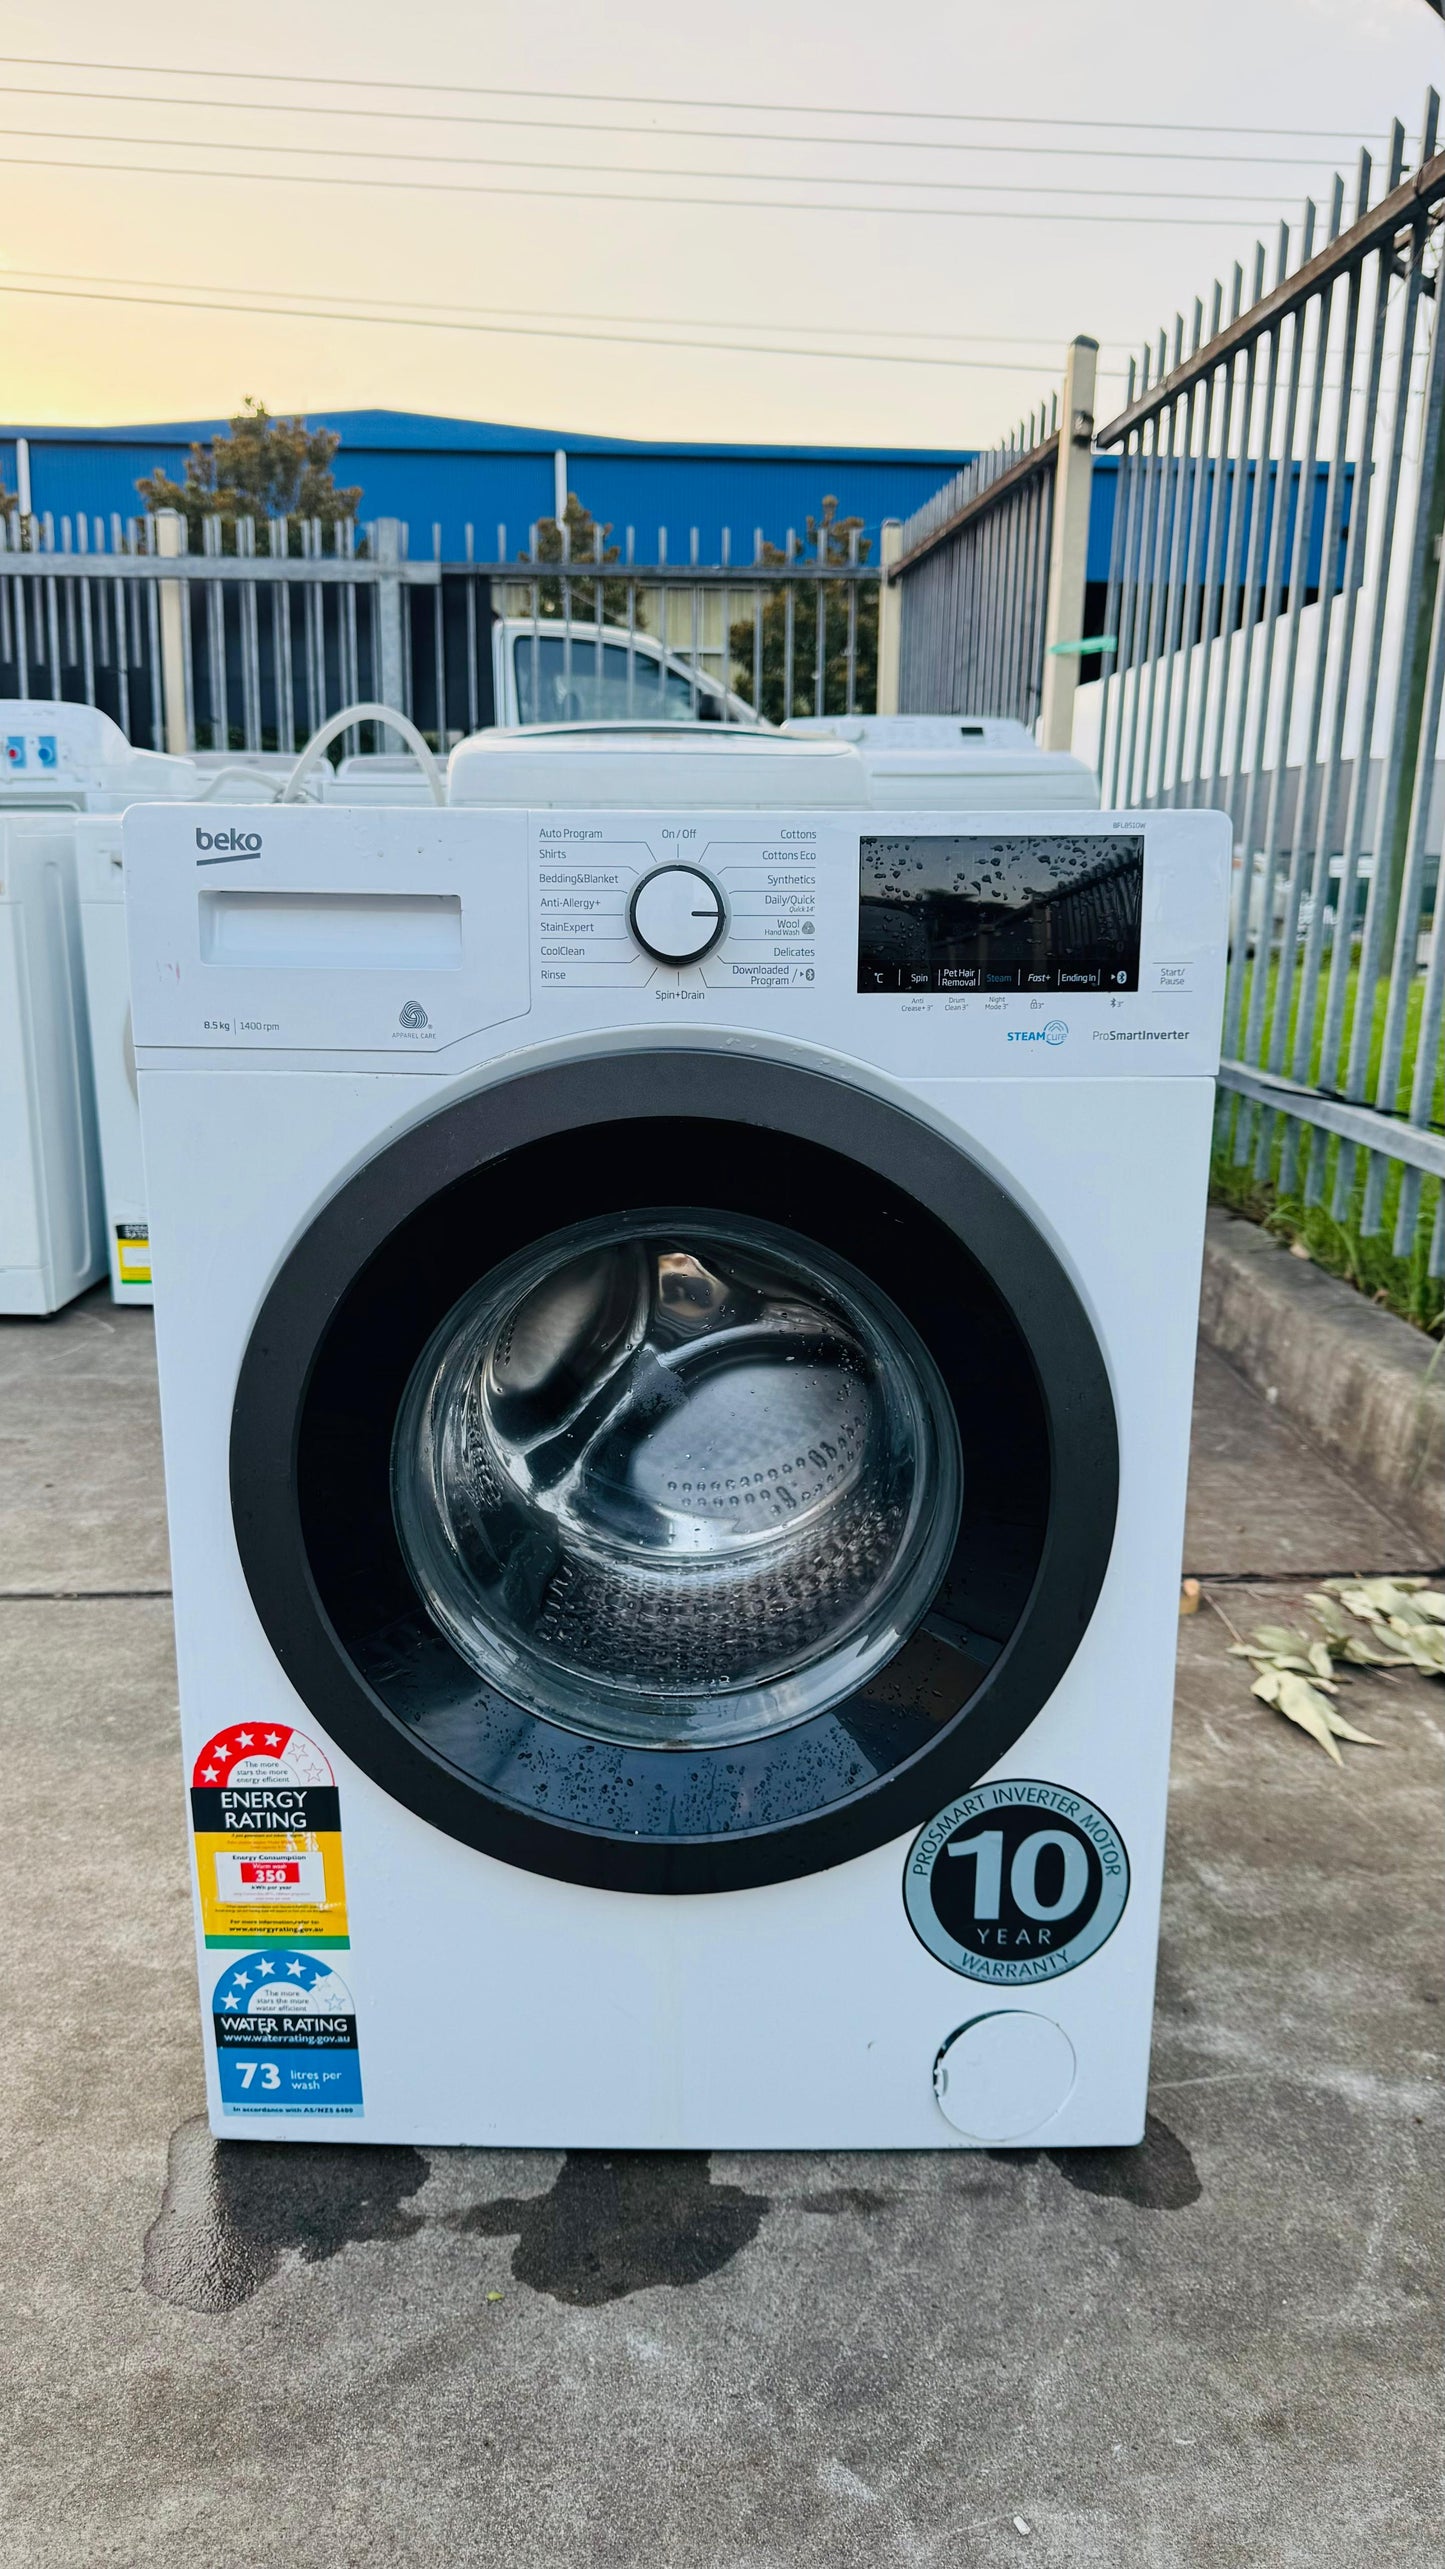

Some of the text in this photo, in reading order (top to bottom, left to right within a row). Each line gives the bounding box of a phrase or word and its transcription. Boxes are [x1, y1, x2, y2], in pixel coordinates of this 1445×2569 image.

[539, 828, 603, 840] Auto Program
[662, 829, 675, 839] On
[683, 828, 697, 839] Off
[780, 830, 817, 839] Cottons
[196, 828, 262, 851] beko
[539, 849, 567, 859] Shirts
[762, 850, 817, 860] Cottons Eco
[539, 874, 618, 886] Bedding&Blanket
[767, 874, 816, 886] Synthetics
[540, 898, 601, 910] Anti-Allergy+
[765, 895, 815, 906] Daily/Quick
[540, 922, 595, 934] StainExpert
[777, 919, 800, 928] Wool
[540, 946, 585, 956] CoolClean
[774, 947, 816, 957] Delicates
[541, 970, 566, 980] Rinse
[732, 965, 789, 975] Downloaded
[943, 969, 975, 977] Pet Hair
[1160, 968, 1186, 977] Start/
[750, 976, 789, 987] Program
[911, 974, 928, 984] Spin
[942, 978, 976, 986] Removal
[986, 972, 1012, 983] Steam
[1028, 973, 1051, 982] Fast+
[1061, 974, 1096, 984] Ending In
[655, 990, 705, 1001] Spin+Drain
[204, 1021, 230, 1031] 8.5 kg
[240, 1022, 262, 1030] 1400
[1092, 1029, 1190, 1041] ProSmartInverter
[221, 1791, 308, 1808] ENERGY
[225, 1812, 307, 1828] RATING
[913, 1786, 1122, 1876] PROSMART INVERTER MOTOR
[256, 1870, 286, 1882] 350
[947, 1830, 1089, 1921] 10
[977, 1928, 1052, 1944] YEAR
[962, 1949, 1069, 1977] WARRANTY
[221, 2017, 348, 2032] WATER RATING
[224, 2034, 350, 2044] www.waterrating.gov.au
[236, 2062, 281, 2090] 73
[290, 2070, 342, 2082] litres per
[291, 2081, 320, 2090] wash
